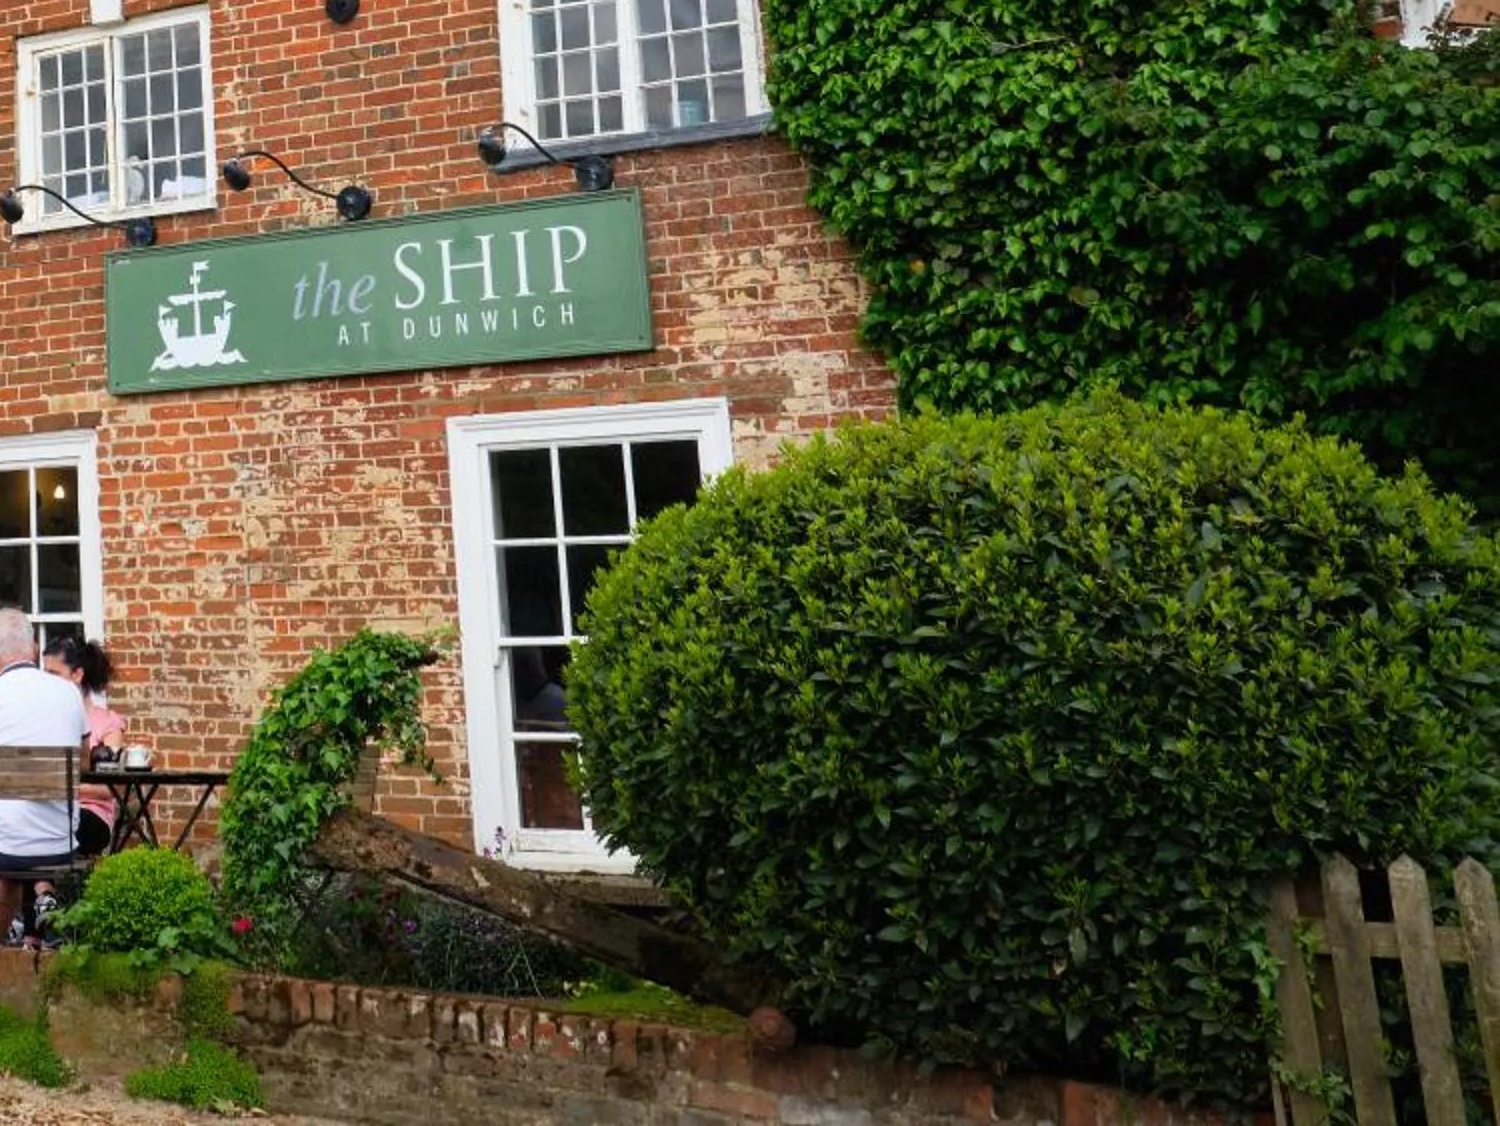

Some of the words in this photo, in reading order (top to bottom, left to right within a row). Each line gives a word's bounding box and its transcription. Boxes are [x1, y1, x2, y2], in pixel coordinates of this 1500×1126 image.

[292, 260, 377, 320] the
[393, 224, 587, 310] SHIP
[338, 321, 371, 345] AT
[403, 302, 575, 340] DUNWICH
